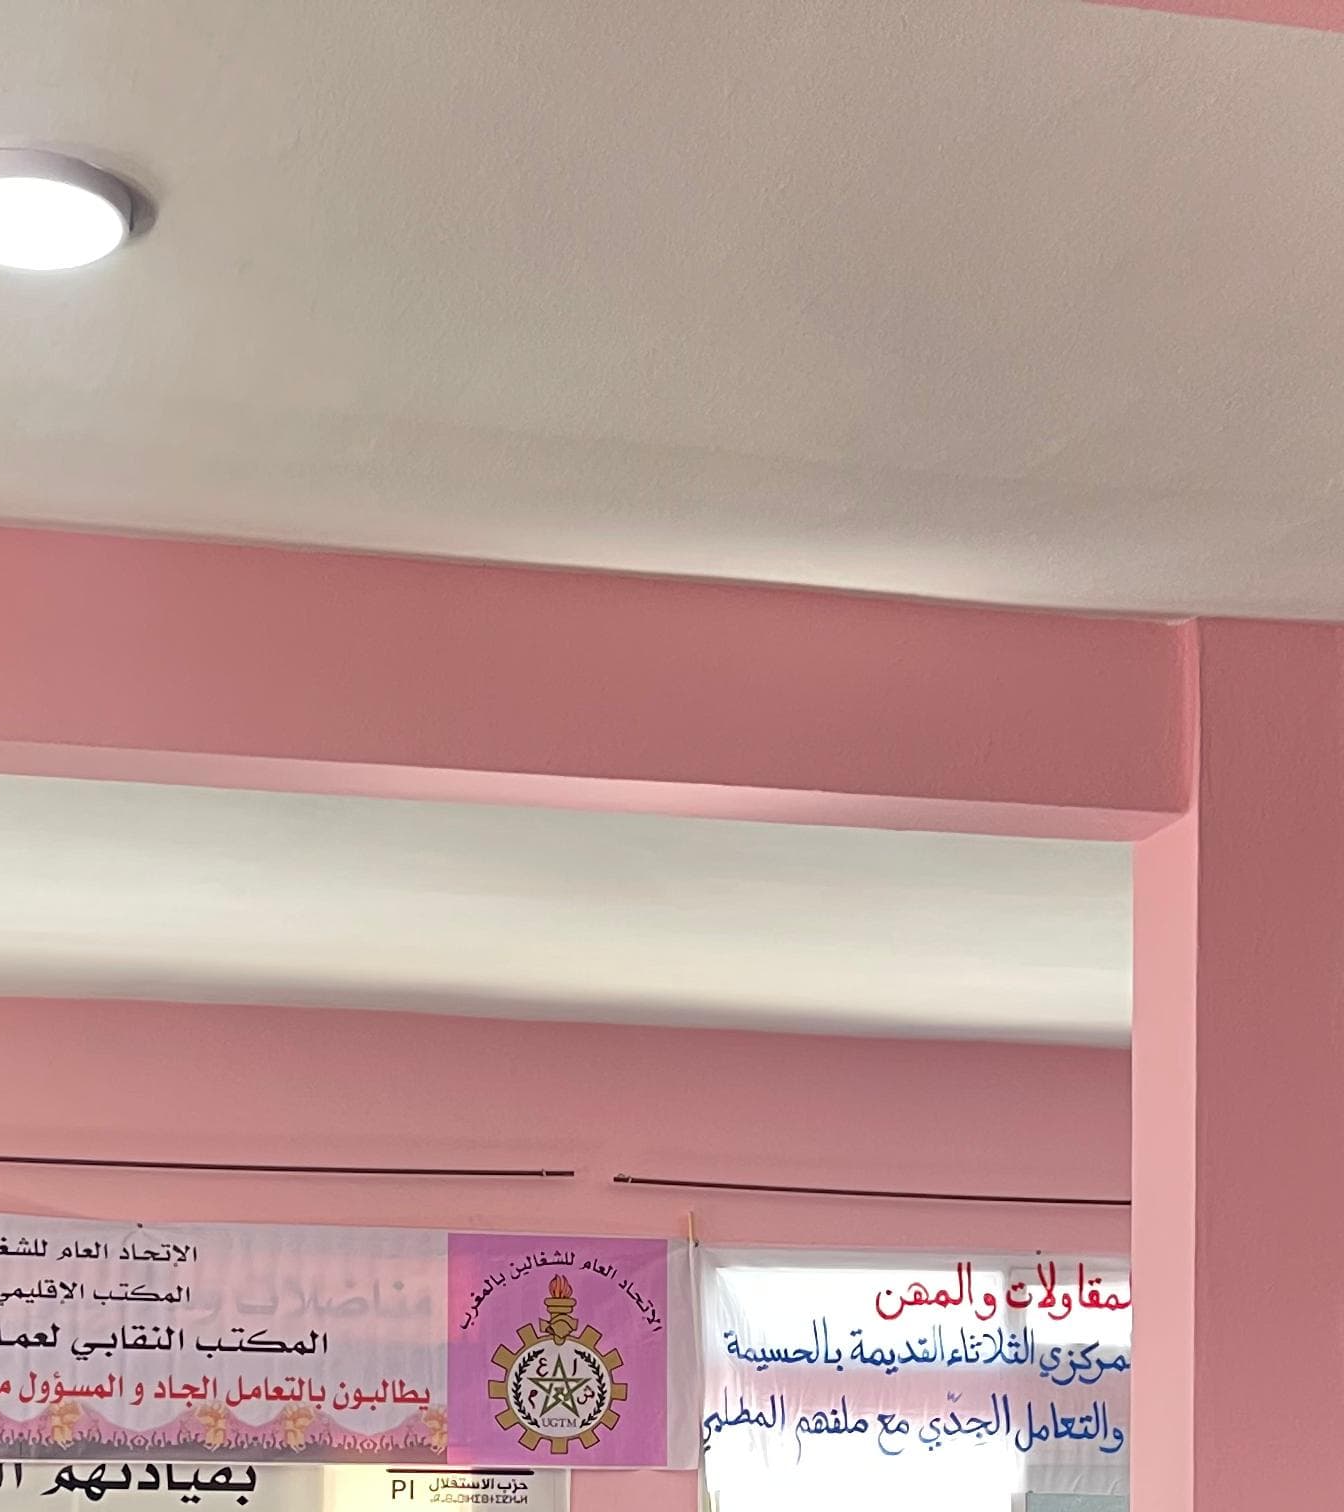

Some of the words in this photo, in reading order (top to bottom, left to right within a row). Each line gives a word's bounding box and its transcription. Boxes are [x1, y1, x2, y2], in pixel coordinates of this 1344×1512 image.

[57, 1241, 109, 1261] العام
[510, 1250, 576, 1280] للشغالين
[579, 1258, 617, 1280] العام
[93, 1283, 191, 1306] المكتب
[460, 1272, 506, 1330] بالمغرب
[875, 1261, 997, 1320] والمهن
[71, 1325, 184, 1361] النقابي
[195, 1327, 328, 1359] المكتب
[723, 1316, 843, 1373] بالحسيمة
[849, 1323, 944, 1376] القديمة
[946, 1325, 1035, 1368] الثلاثاء
[1039, 1341, 1131, 1386] مركزي
[19, 1371, 124, 1405] المسؤول
[128, 1382, 145, 1405] و
[154, 1374, 218, 1408] الجاد
[225, 1375, 327, 1410] بالتعامل
[333, 1379, 431, 1411] يطالبون
[542, 1417, 577, 1428] UGTM
[877, 1413, 911, 1456] مع
[1014, 1401, 1125, 1453] والتعامل
[392, 1479, 414, 1500] PI
[429, 1476, 495, 1492] الاستقلال
[497, 1478, 528, 1493] حزب
